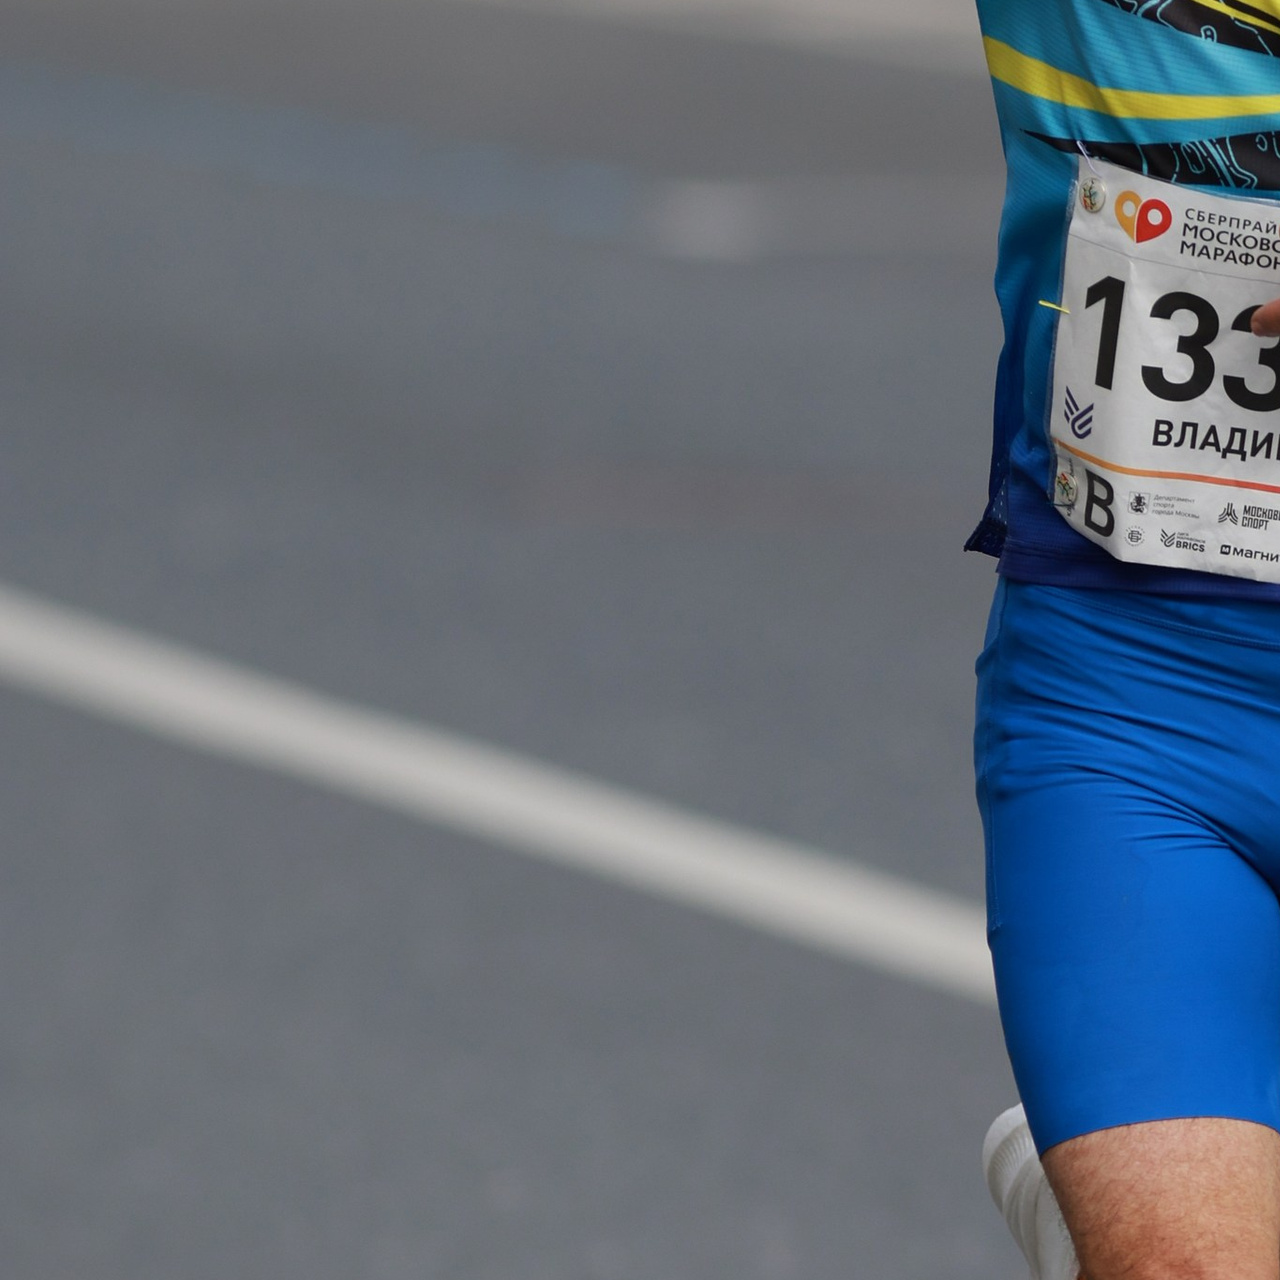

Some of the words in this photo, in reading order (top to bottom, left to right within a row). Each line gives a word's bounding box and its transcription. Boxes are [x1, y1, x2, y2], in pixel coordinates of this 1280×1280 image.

[1185, 208, 1277, 235] СБЕРПРАЙ
[1241, 516, 1270, 531] СПОРТ
[1175, 540, 1205, 553] BRICS
